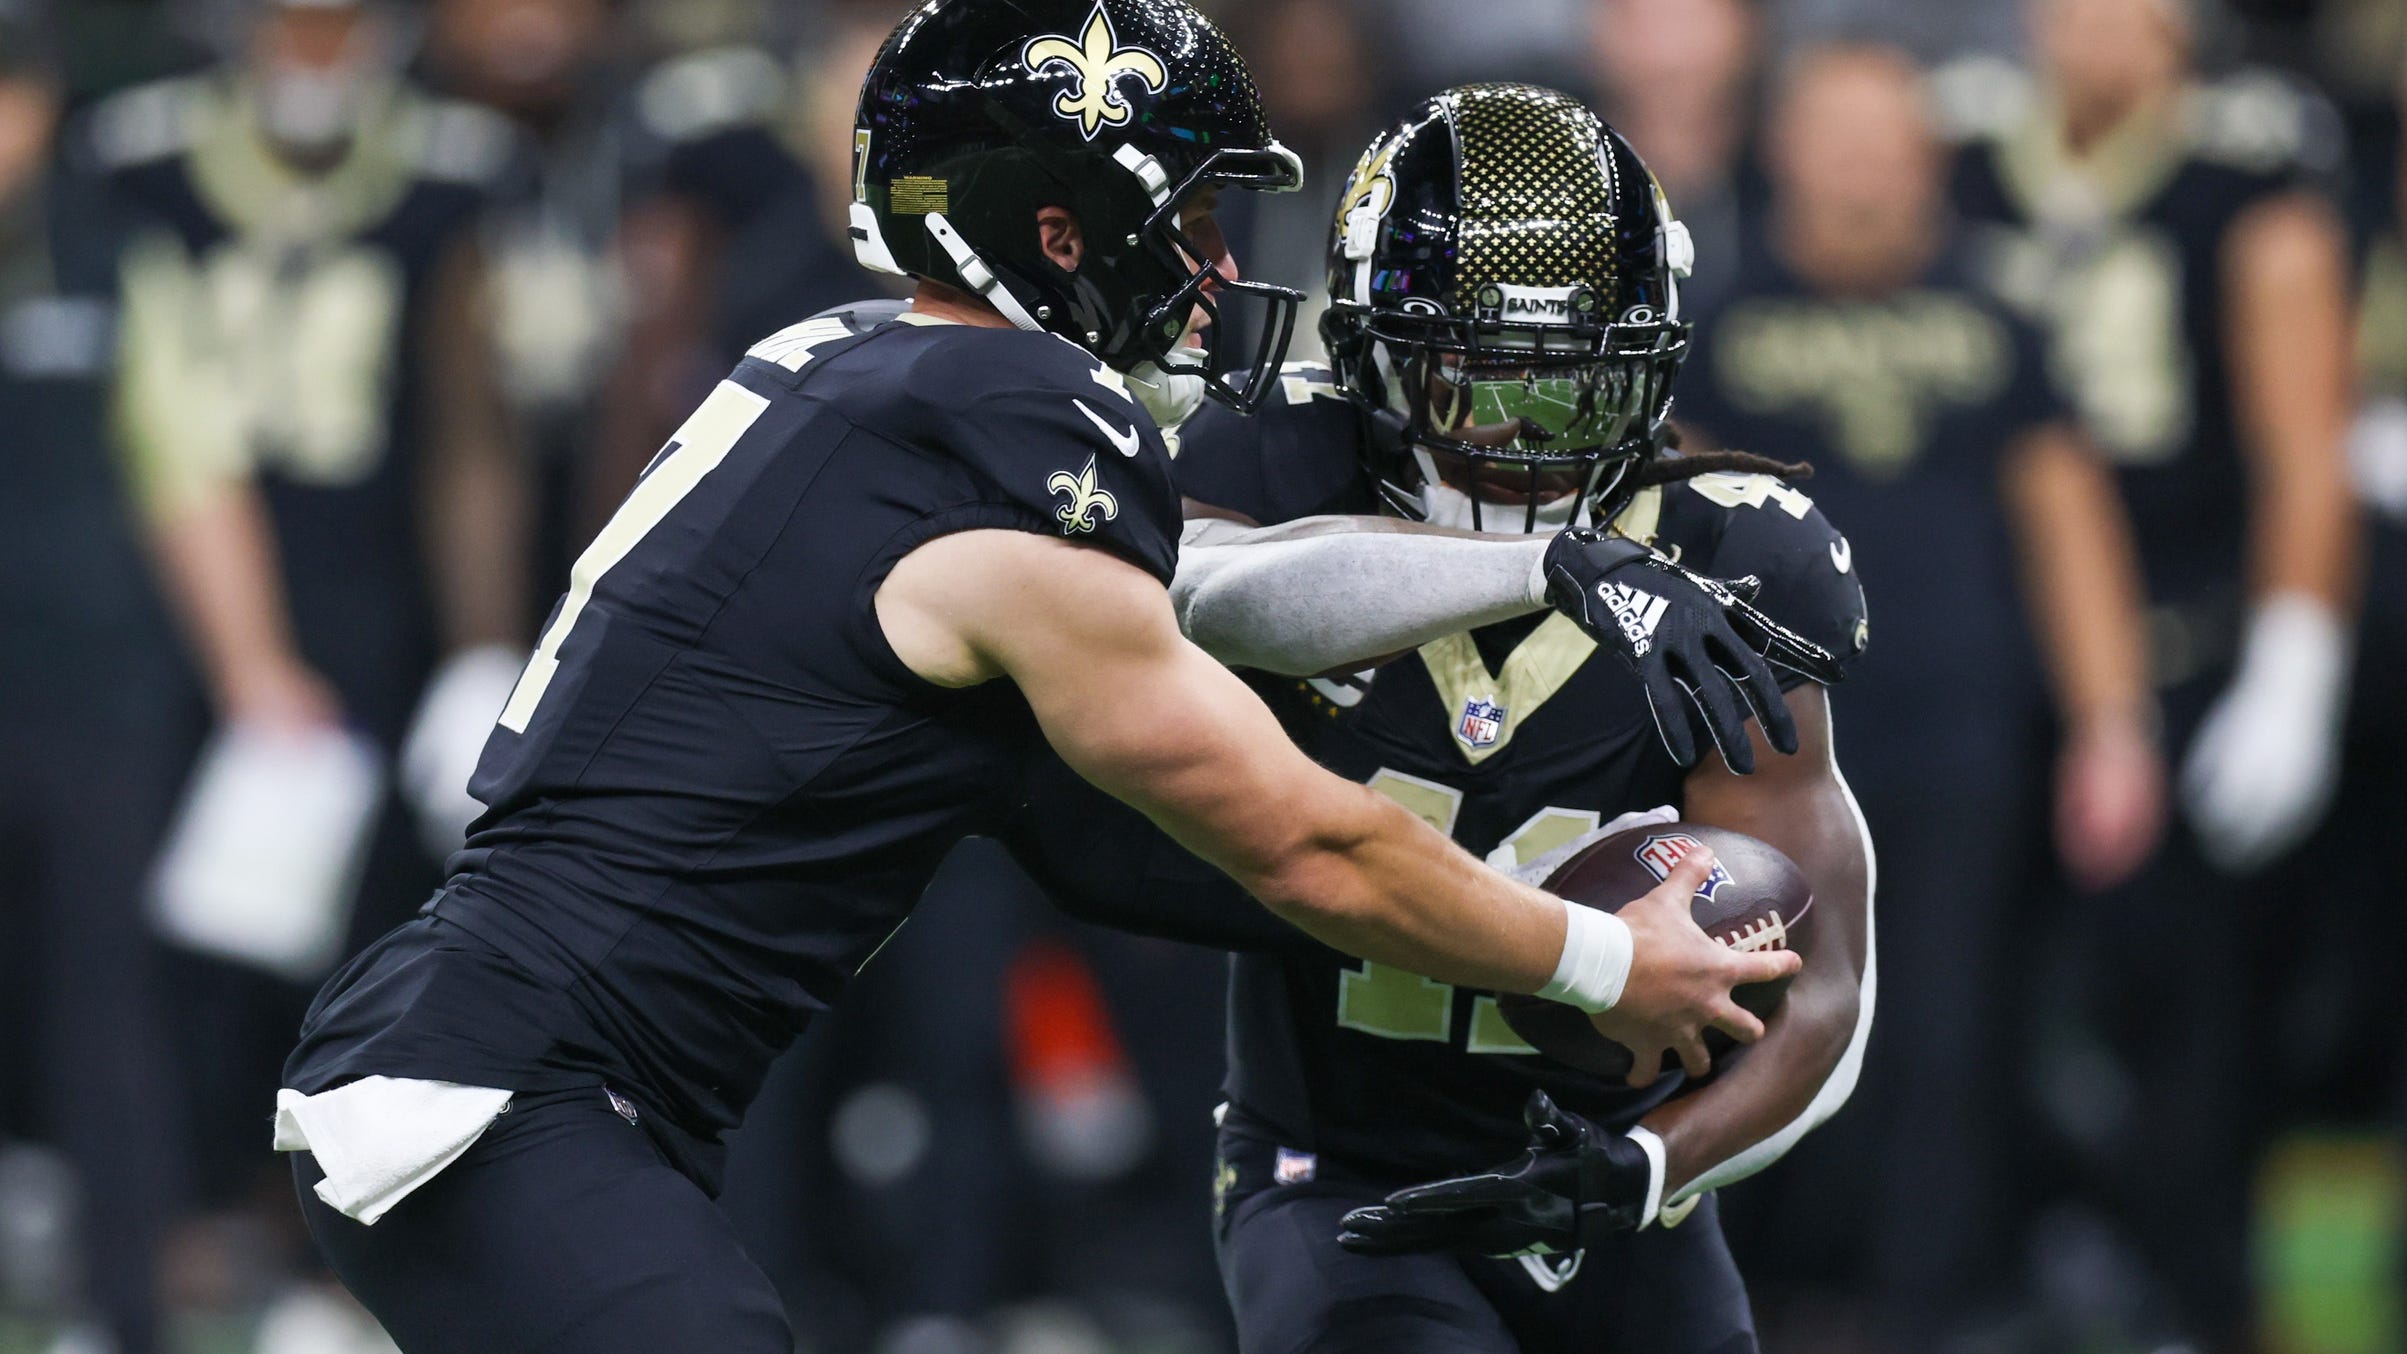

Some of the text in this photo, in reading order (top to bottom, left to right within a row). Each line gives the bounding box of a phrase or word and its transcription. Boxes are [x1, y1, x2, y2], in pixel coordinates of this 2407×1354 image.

[855, 128, 871, 202] 7
[1507, 297, 1567, 315] SAINTS
[497, 379, 771, 734] 7
[1597, 581, 1651, 658] adidas
[1463, 717, 1493, 741] NFL
